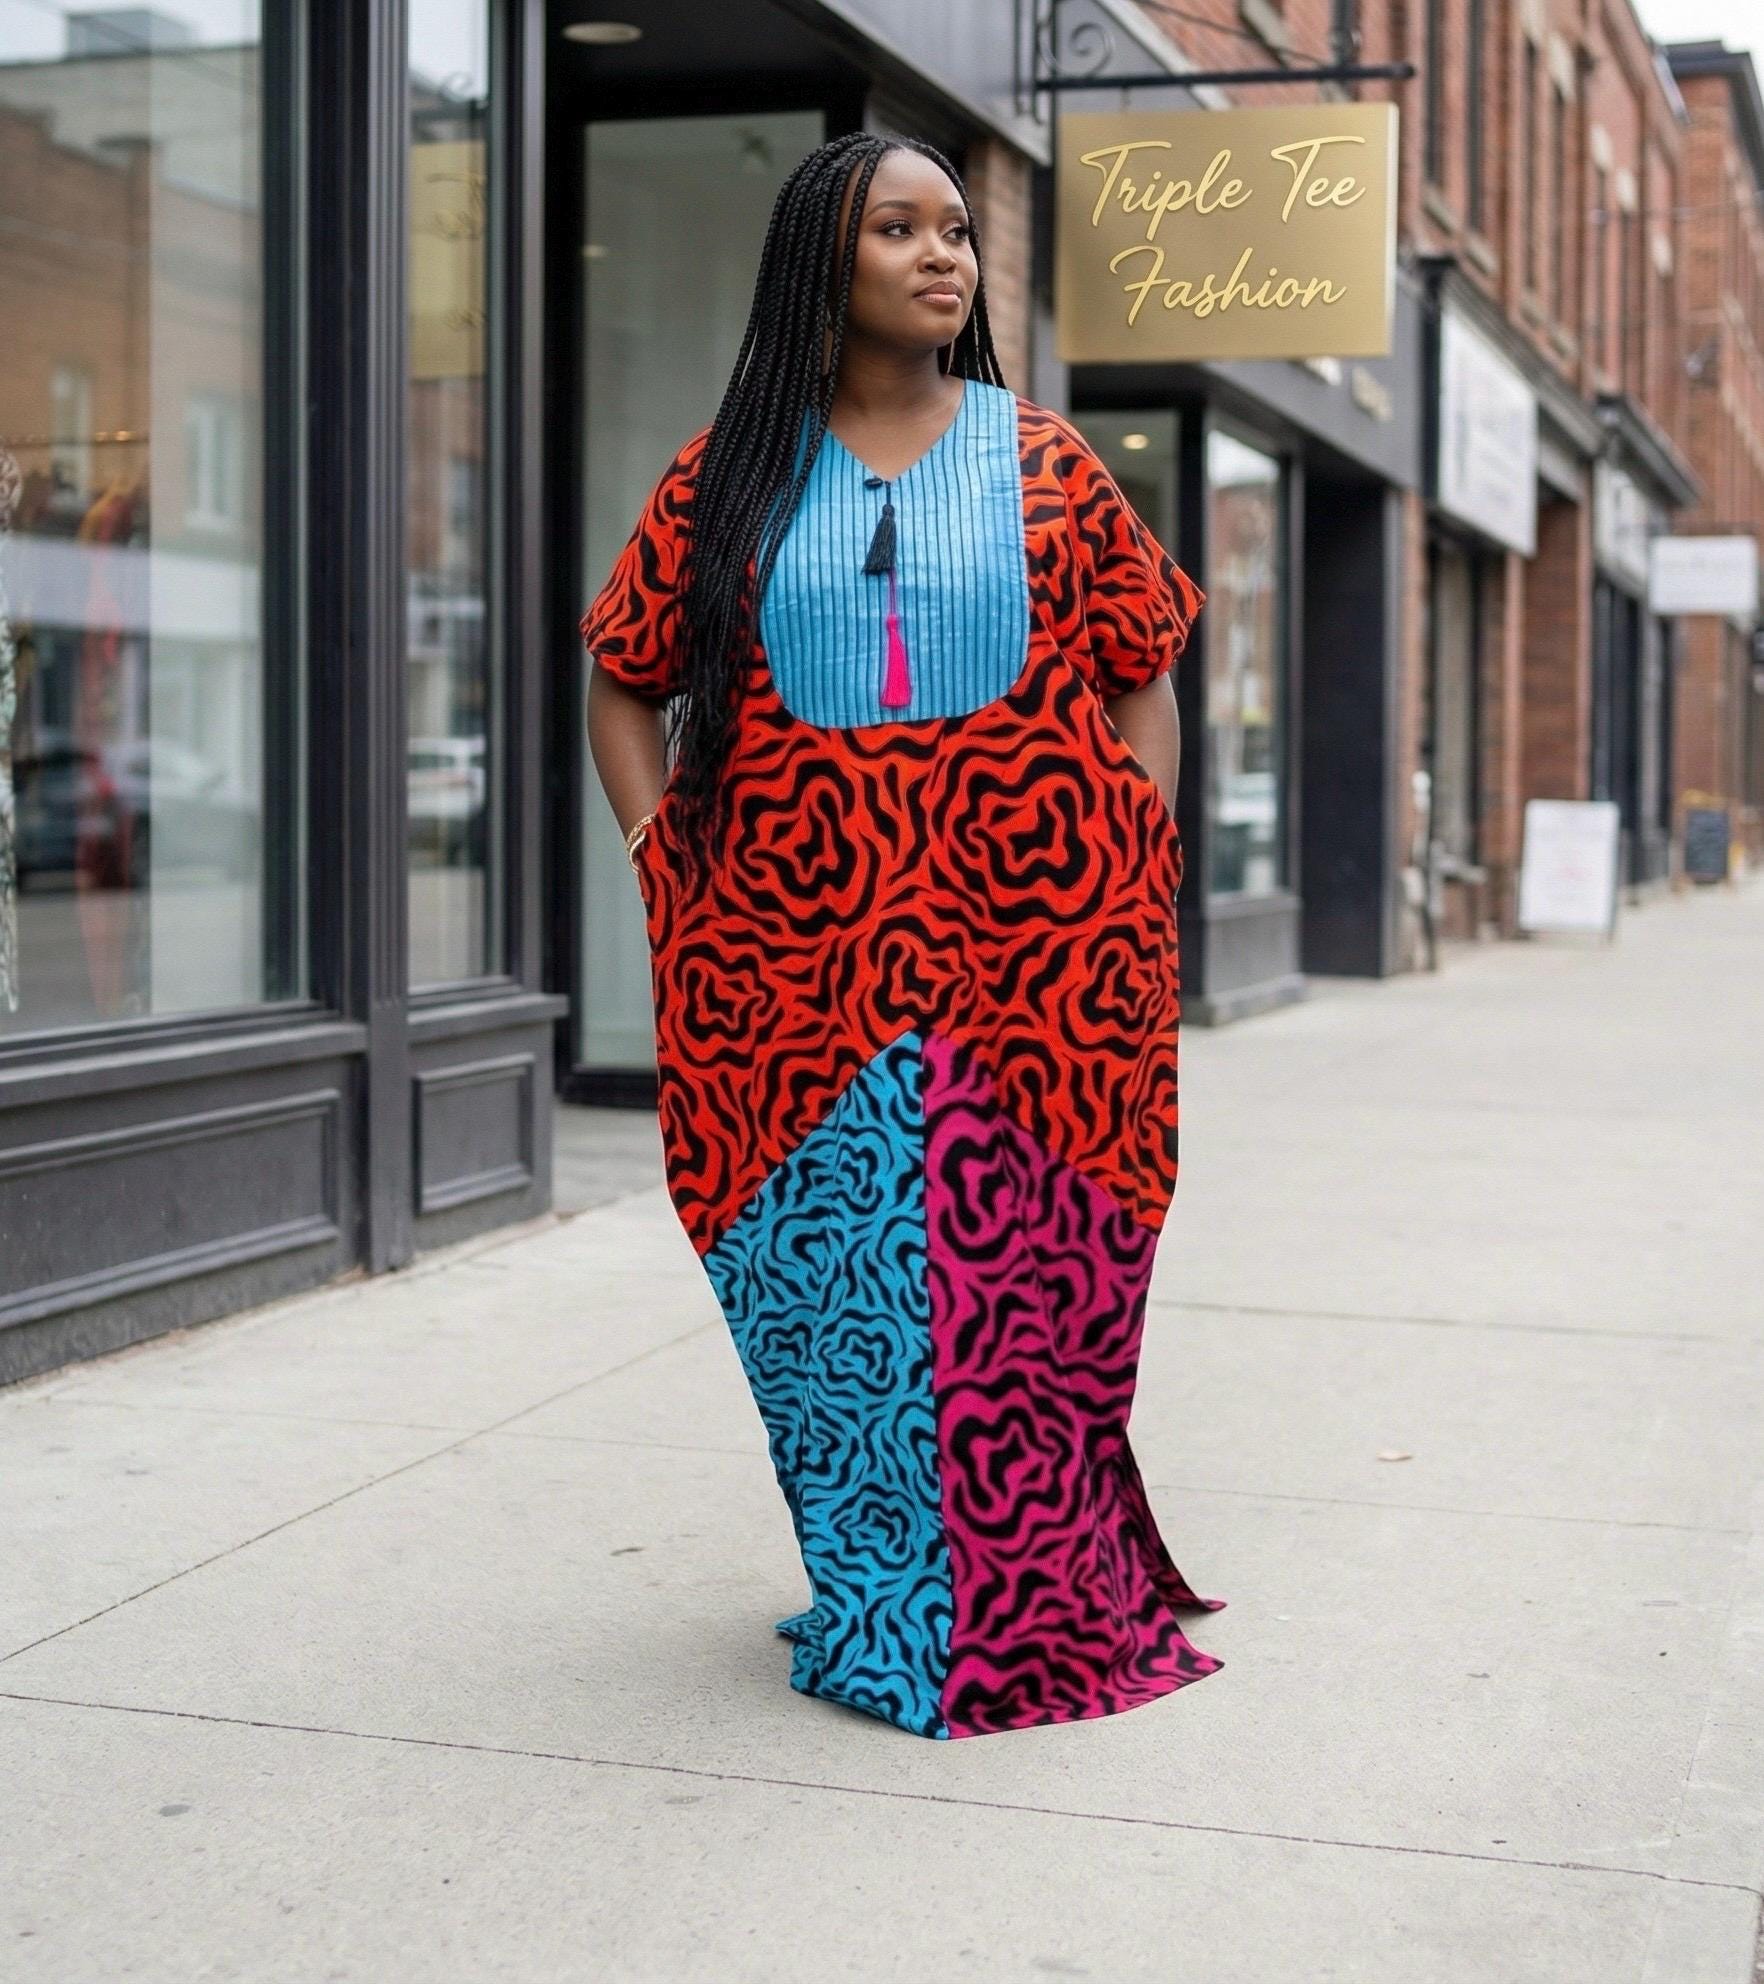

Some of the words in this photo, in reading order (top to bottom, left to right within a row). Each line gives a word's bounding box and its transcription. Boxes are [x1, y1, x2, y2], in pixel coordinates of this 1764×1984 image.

[1080, 141, 1253, 241] Triple
[1271, 136, 1366, 223] Tee
[1109, 245, 1347, 327] Fashion
